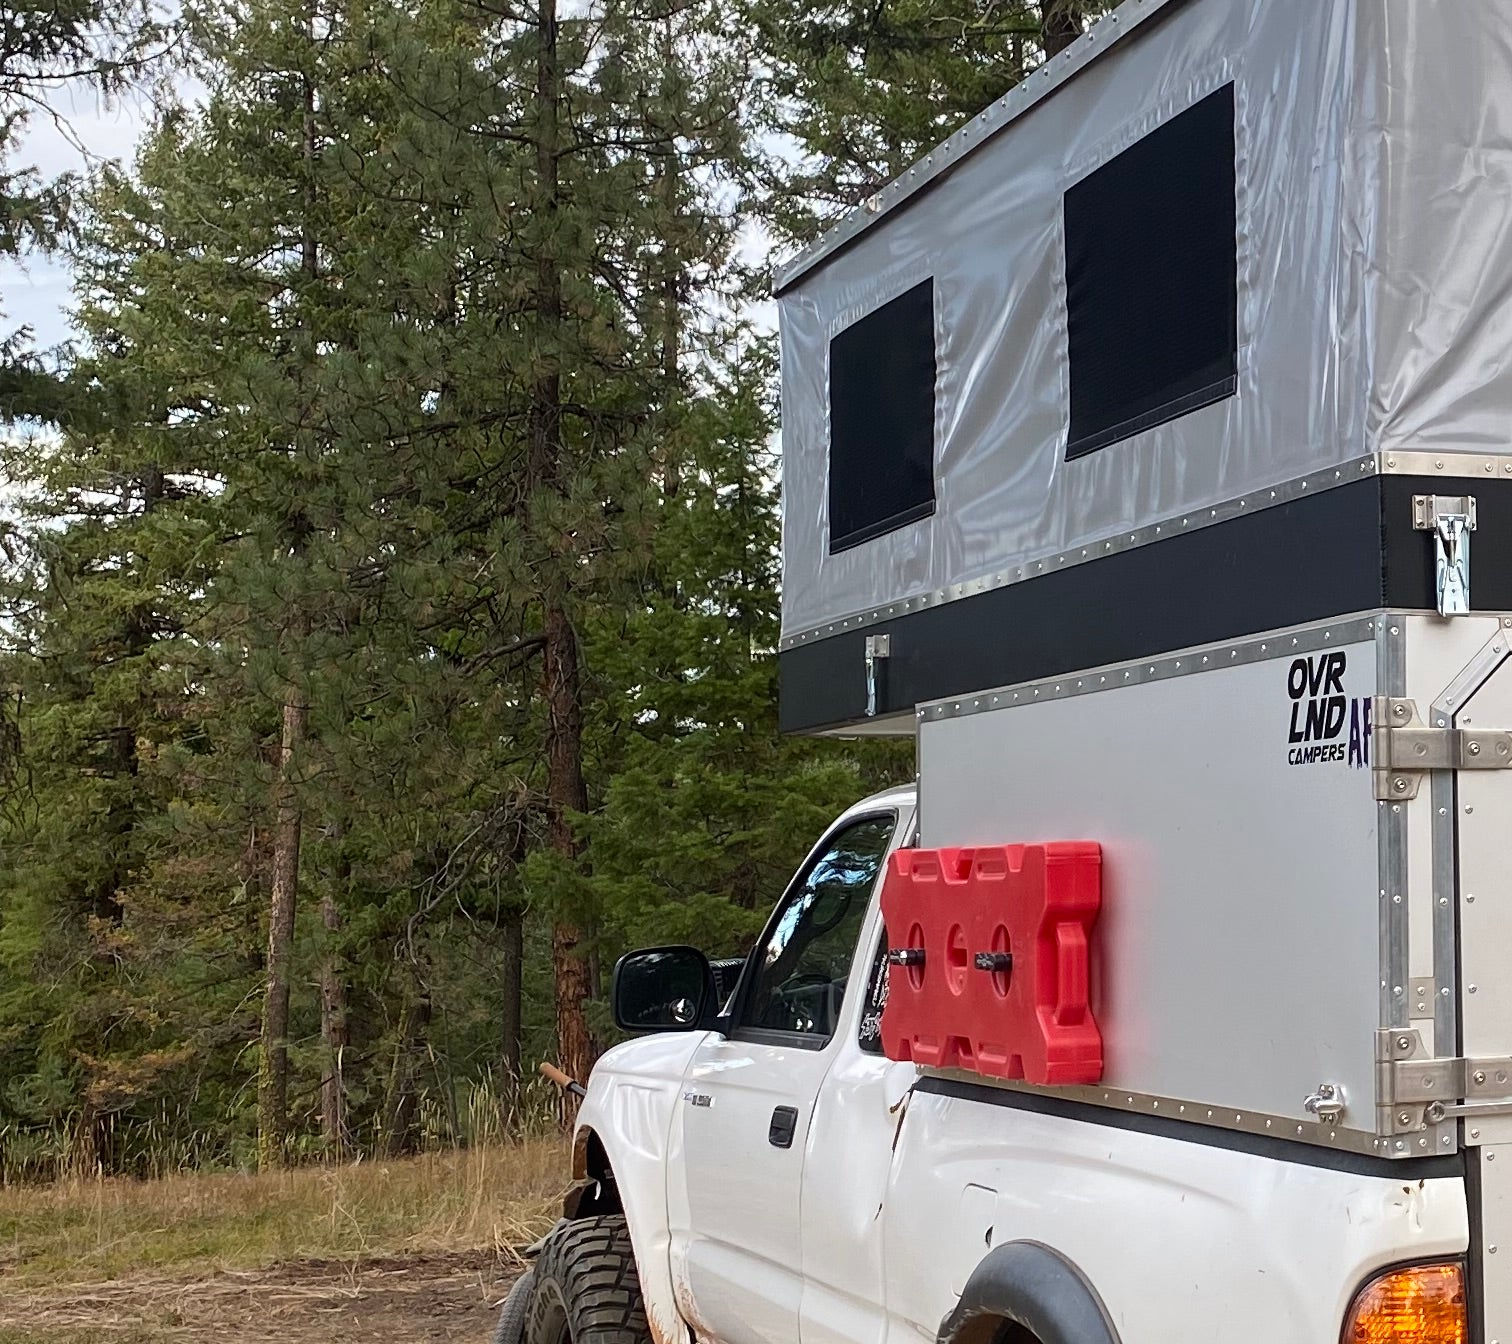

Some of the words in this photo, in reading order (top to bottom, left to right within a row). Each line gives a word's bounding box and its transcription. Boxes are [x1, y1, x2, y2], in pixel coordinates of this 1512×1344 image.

[1287, 651, 1347, 699] OVR
[1288, 695, 1347, 744] LND
[1288, 742, 1347, 766] CAMPERS
